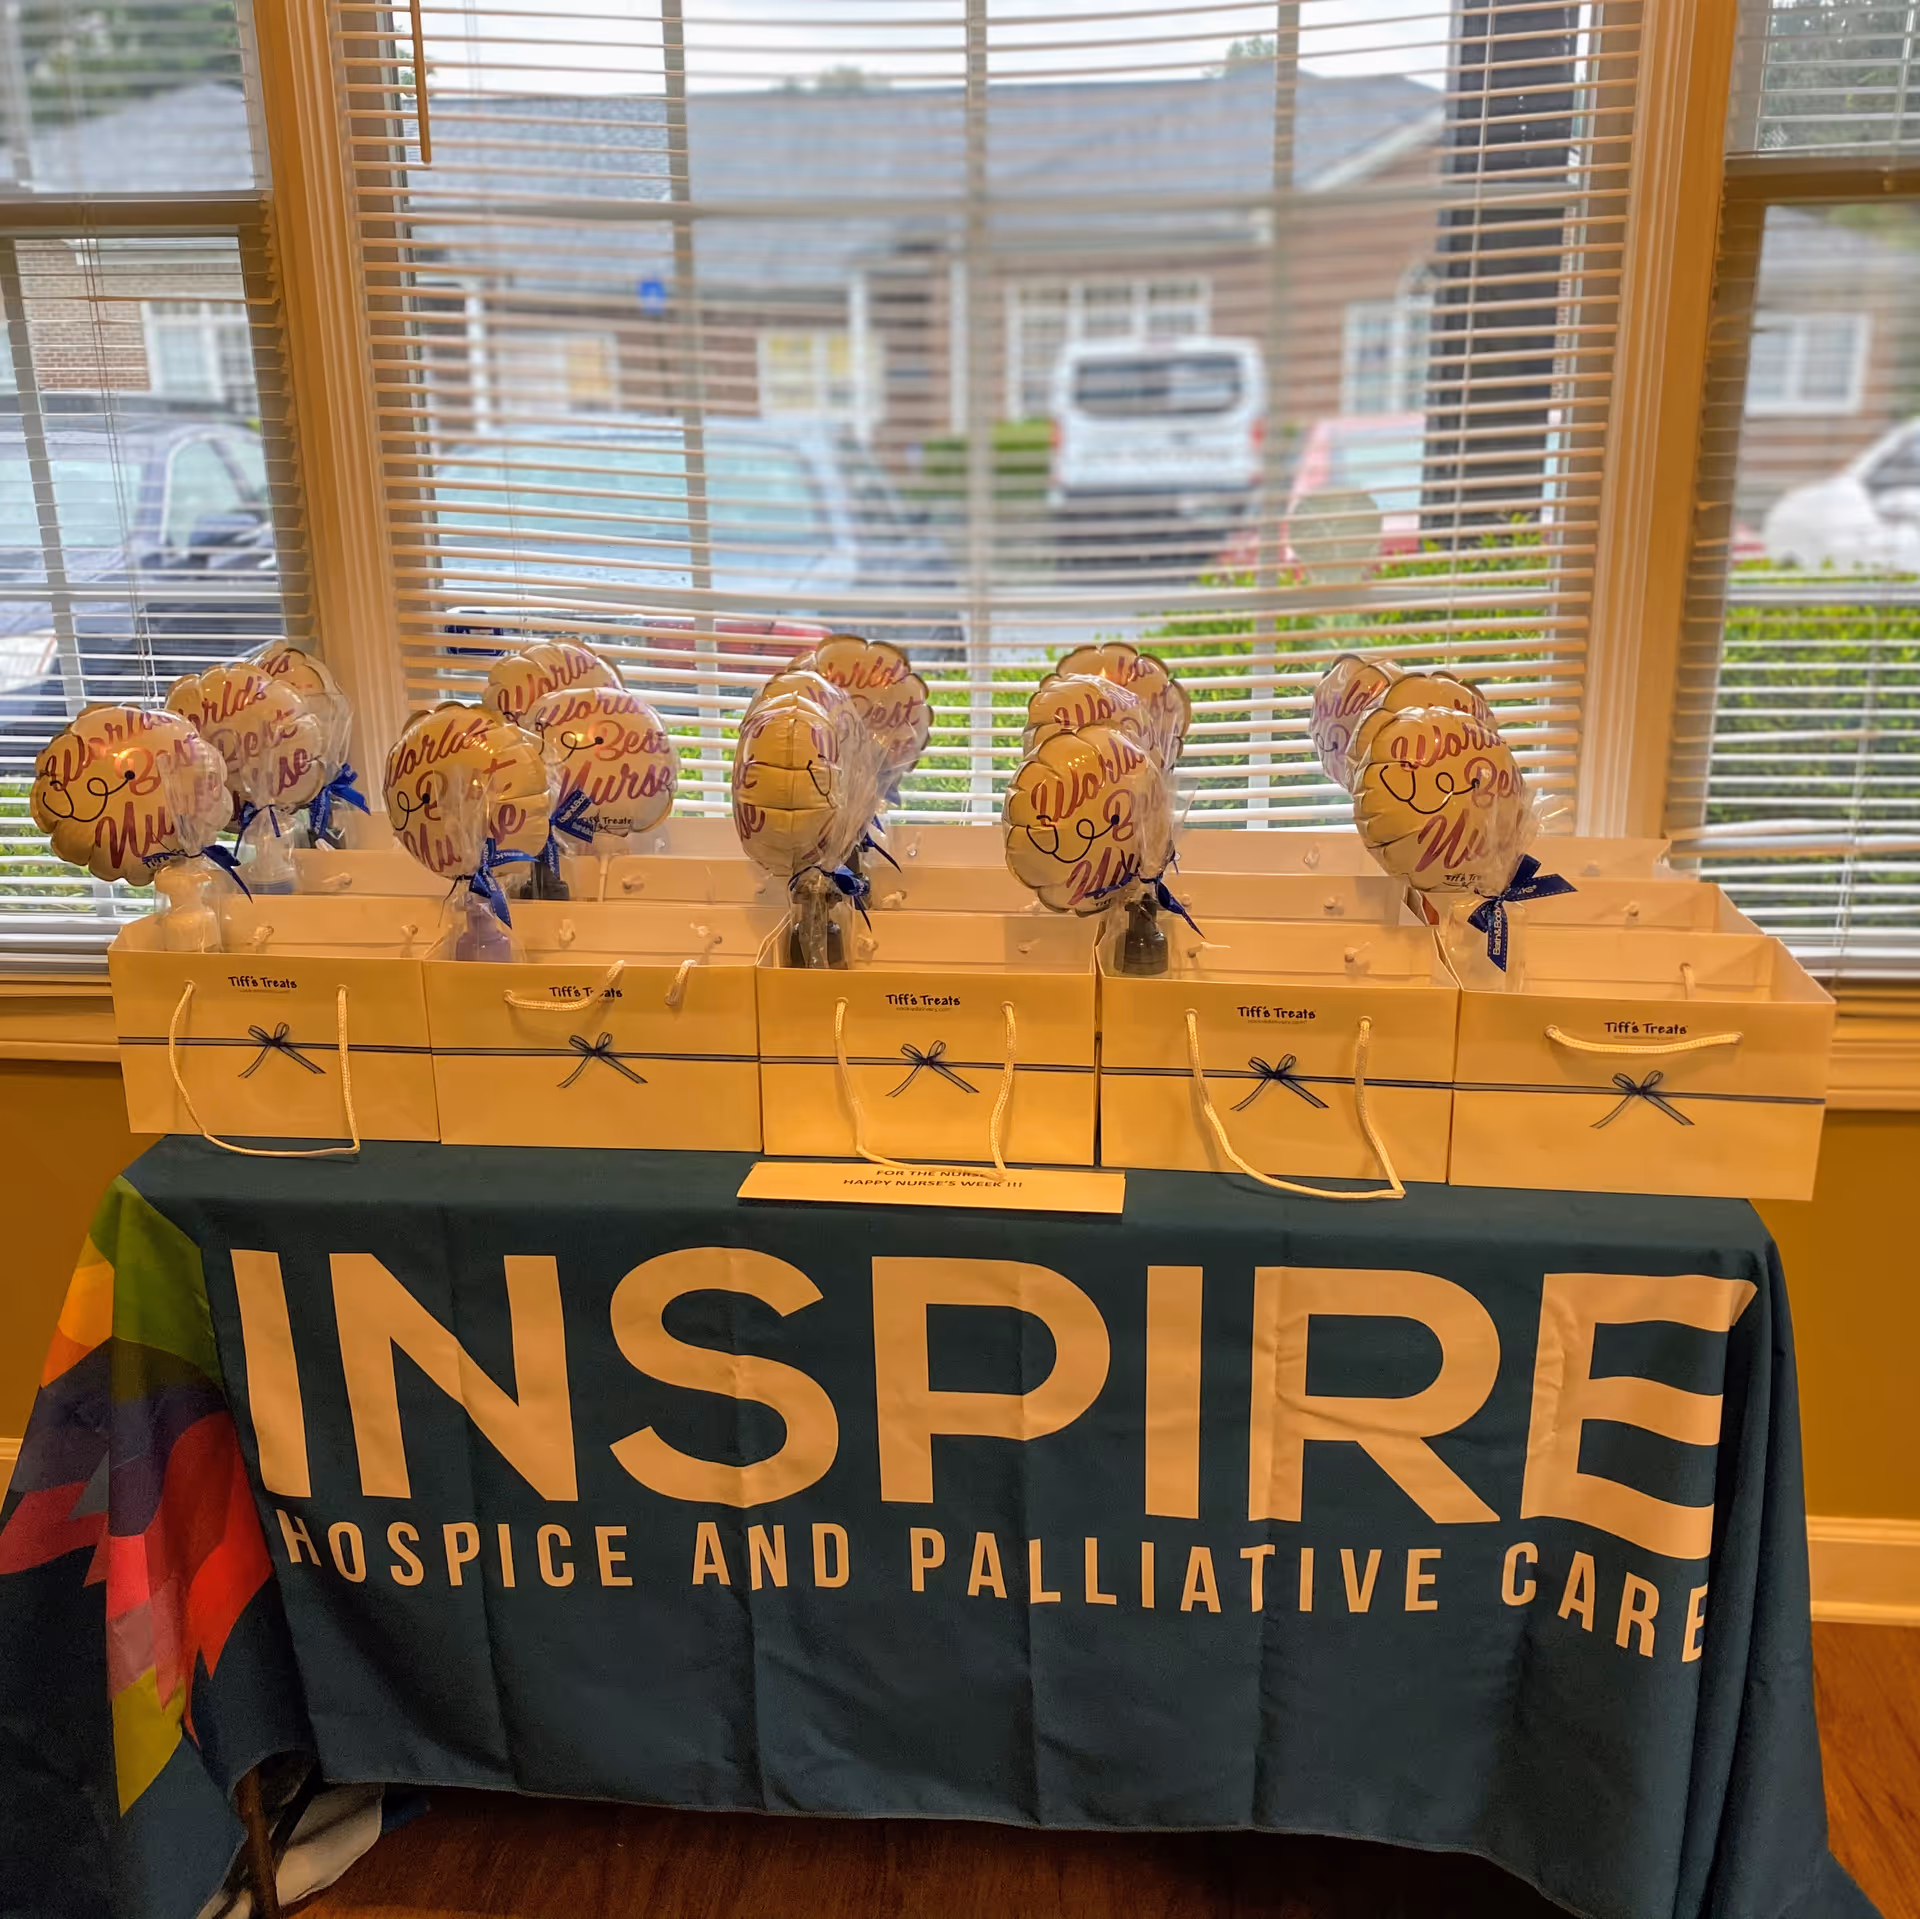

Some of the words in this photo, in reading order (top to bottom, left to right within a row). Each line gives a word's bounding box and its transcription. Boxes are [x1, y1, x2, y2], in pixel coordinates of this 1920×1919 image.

[178, 675, 267, 731] orld's
[227, 975, 259, 988] Tiff's
[259, 976, 298, 989] Treats
[548, 985, 581, 998] Tiff's
[582, 986, 623, 998] Tats
[885, 993, 918, 1006] Tiff's
[919, 994, 961, 1006] Treats
[1236, 1005, 1271, 1018] Tiff's
[1273, 1007, 1316, 1020] Treats
[1604, 1021, 1639, 1034] Tiff's
[1642, 1022, 1688, 1035] Treats
[843, 1178, 892, 1187] HAPPY
[895, 1179, 956, 1187] NURSE'S
[230, 1246, 1758, 1560] INSPIRE
[275, 1508, 633, 1588] HOSPICE
[691, 1520, 850, 1591] AND
[909, 1526, 1442, 1613] PALLIATIVE
[1501, 1541, 1708, 1663] CARE
